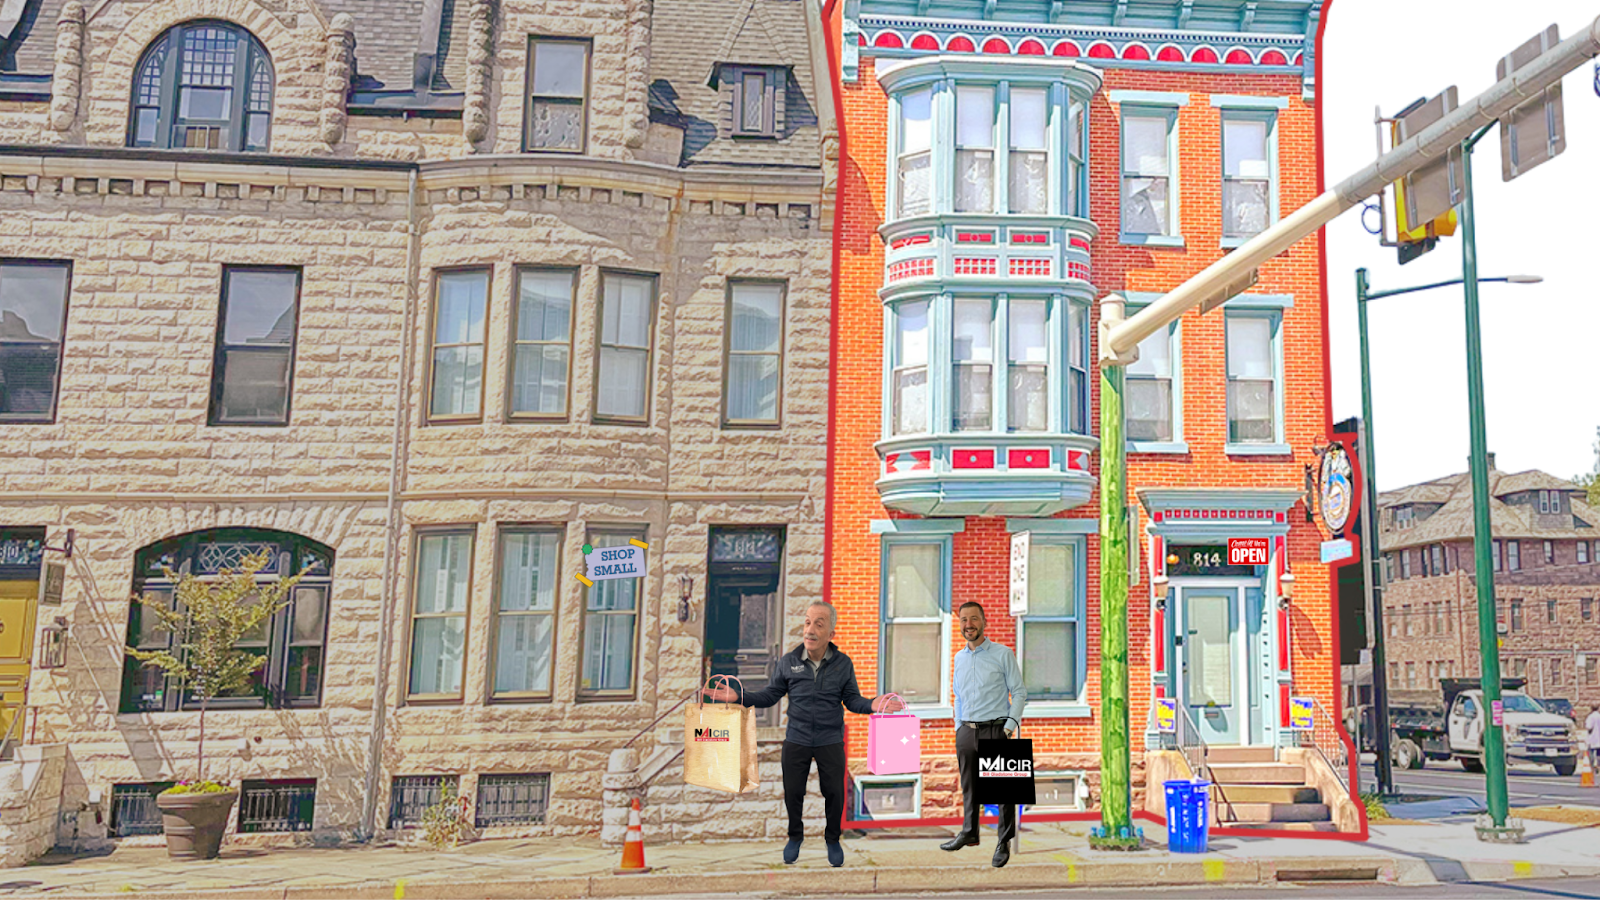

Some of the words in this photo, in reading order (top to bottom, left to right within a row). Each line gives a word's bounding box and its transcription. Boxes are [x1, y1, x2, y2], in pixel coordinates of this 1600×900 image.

[1193, 552, 1221, 567] 814
[1231, 548, 1266, 563] OPEN
[695, 726, 712, 738] NAI
[713, 729, 730, 738] CIR
[979, 754, 1005, 771] NAI
[1006, 759, 1031, 771] CIR
